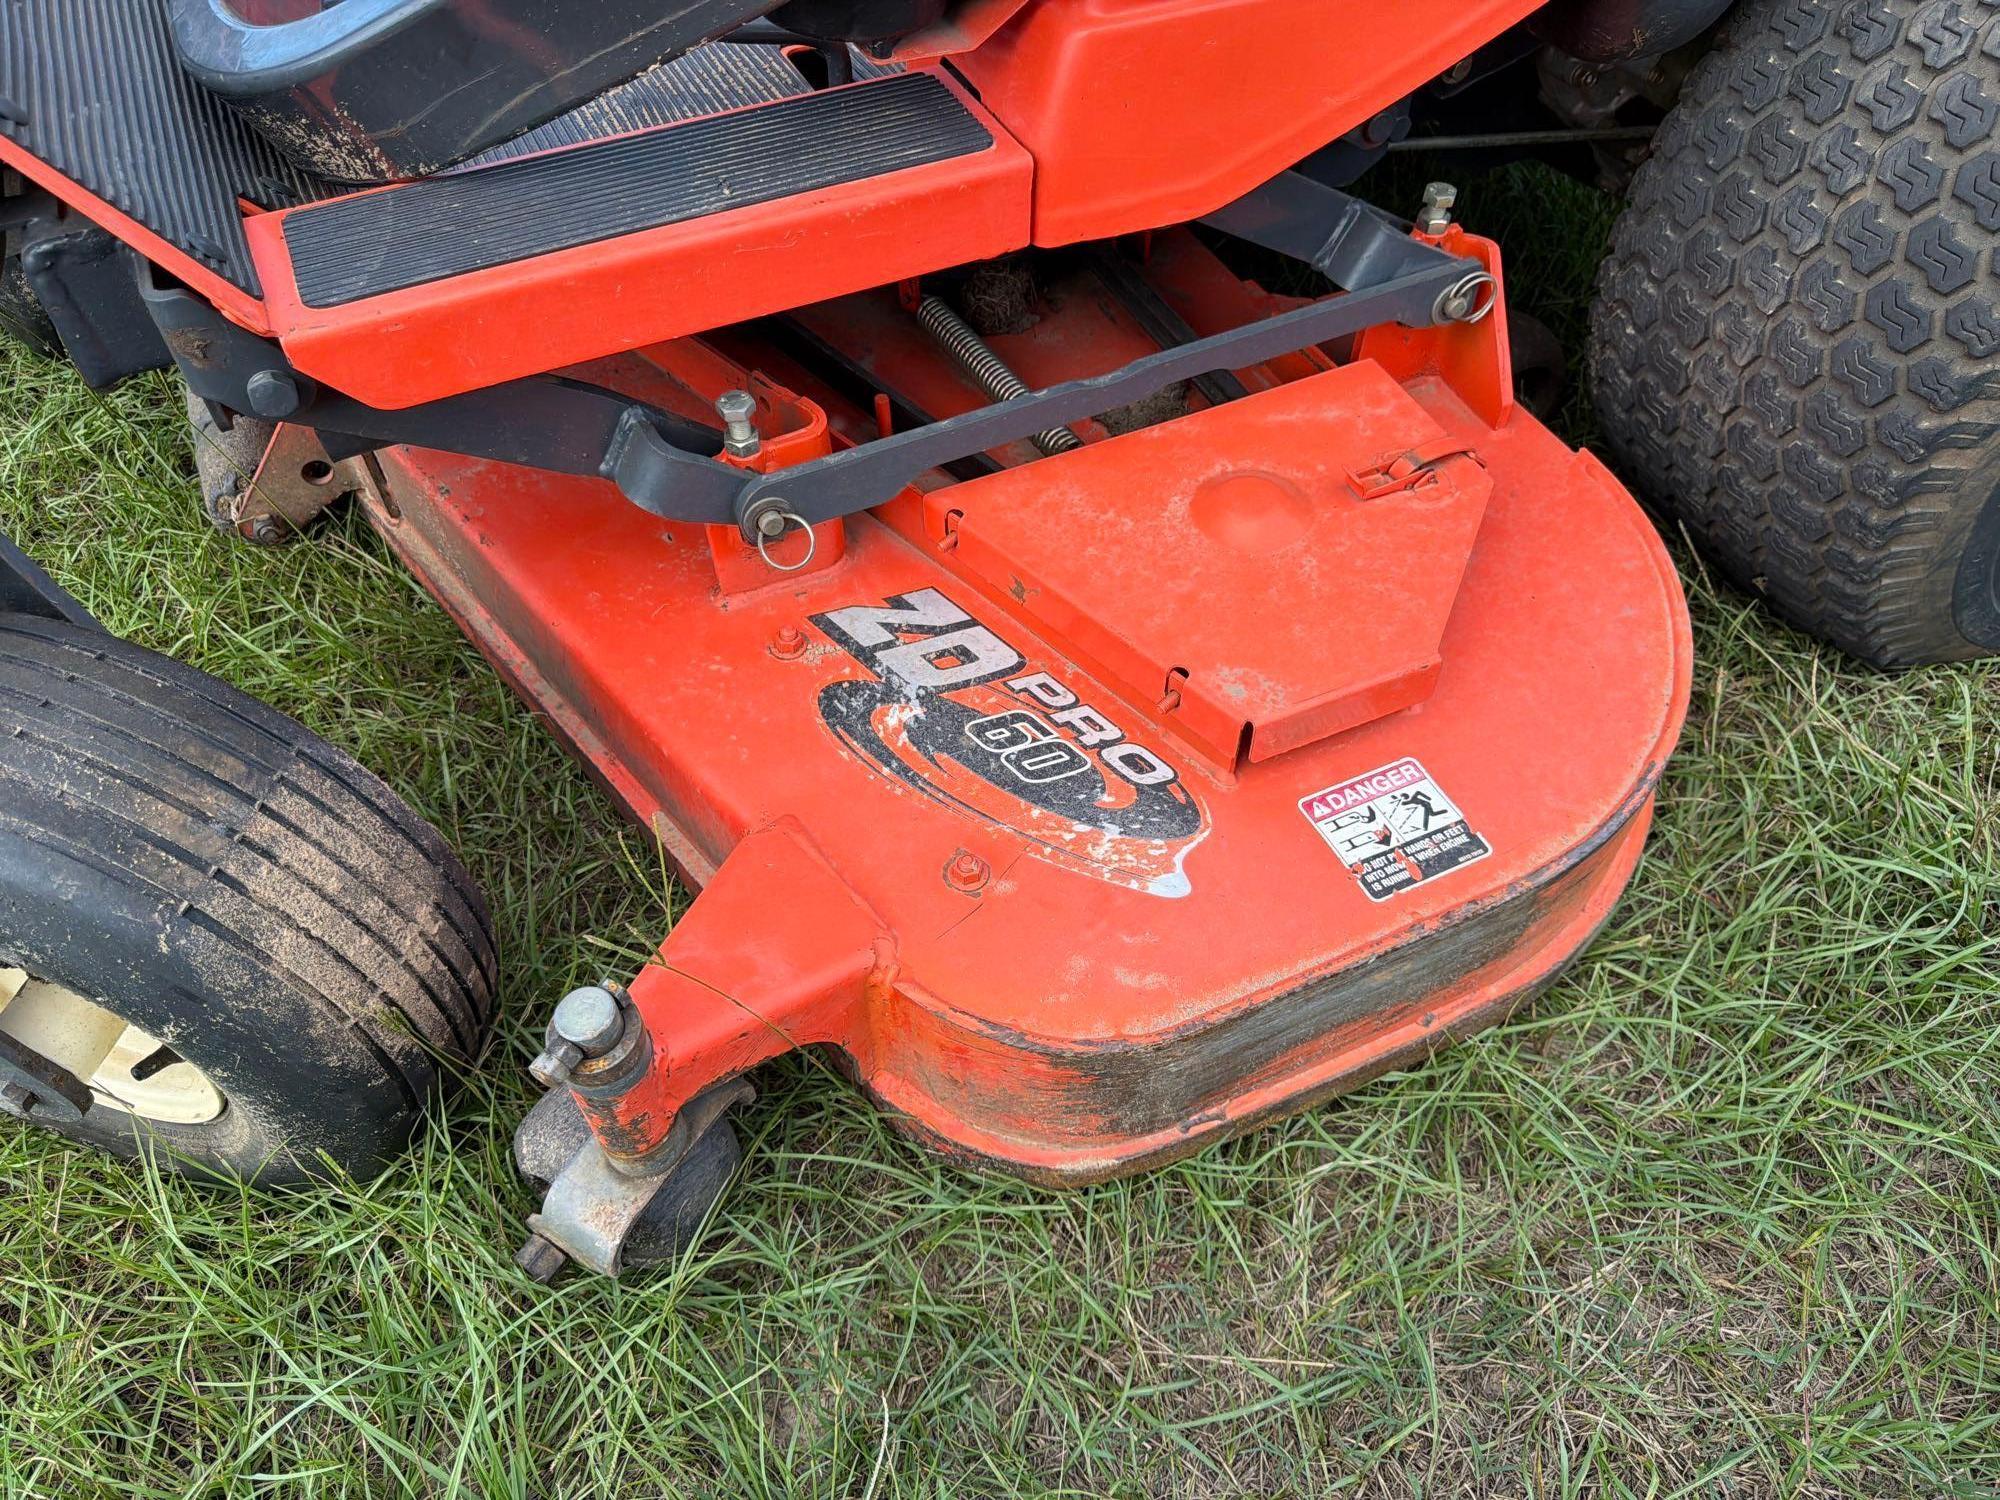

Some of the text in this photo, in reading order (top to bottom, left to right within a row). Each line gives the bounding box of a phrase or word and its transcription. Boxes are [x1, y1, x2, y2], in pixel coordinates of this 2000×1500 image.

[812, 586, 1025, 692] ZD
[965, 710, 1091, 783] 60
[1005, 673, 1178, 785] PRO
[1326, 764, 1419, 807] DANGER
[1365, 870, 1386, 883] INTO
[1384, 855, 1417, 875] MOWR
[1415, 847, 1442, 862] WHEN
[1440, 834, 1470, 853] ENGINE
[1370, 855, 1388, 870] NOT
[1387, 848, 1405, 862] PT
[1404, 838, 1433, 855] HANDS
[1432, 832, 1445, 844] OR
[1443, 825, 1464, 840] FEET
[1371, 882, 1383, 892] IS
